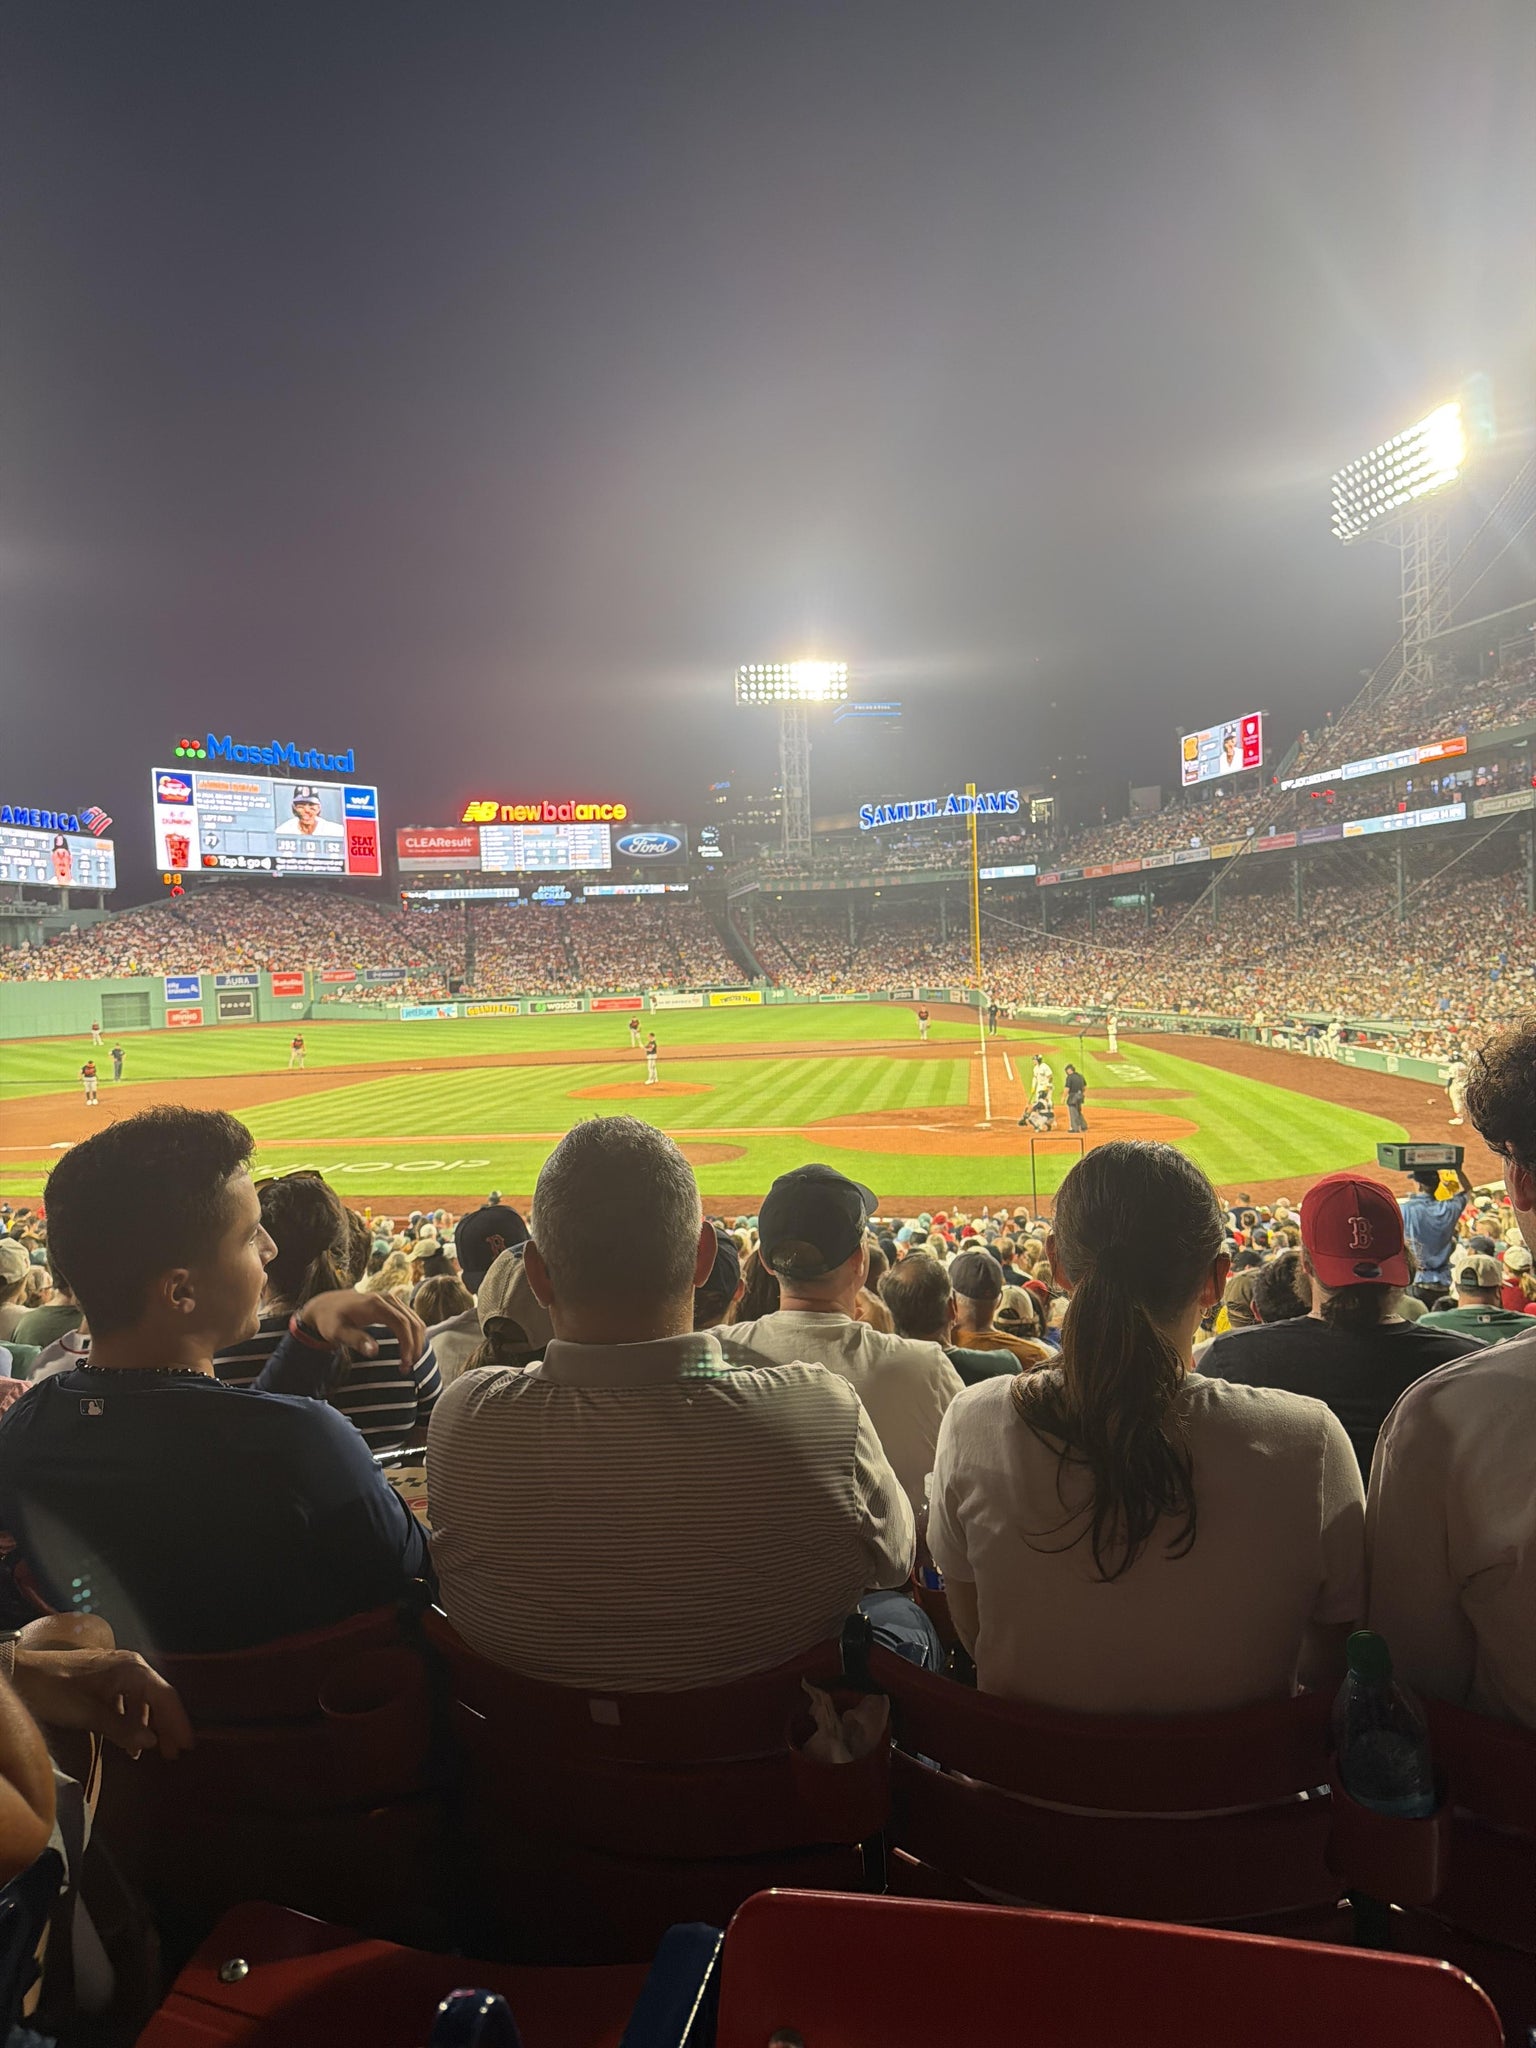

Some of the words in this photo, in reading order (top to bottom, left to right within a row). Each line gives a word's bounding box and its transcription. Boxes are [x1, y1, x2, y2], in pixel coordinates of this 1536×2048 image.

[207, 733, 355, 772] MassMutual
[1, 804, 80, 832] AMERICA
[859, 800, 942, 830] SAMUEL
[943, 790, 1020, 816] ADAMS
[351, 836, 374, 846] SEAT
[405, 837, 472, 848] CLEAResult
[629, 836, 668, 853] Ford
[350, 847, 375, 857] GEEK
[547, 1000, 578, 1010] wasabi
[1347, 1216, 1374, 1250] B
